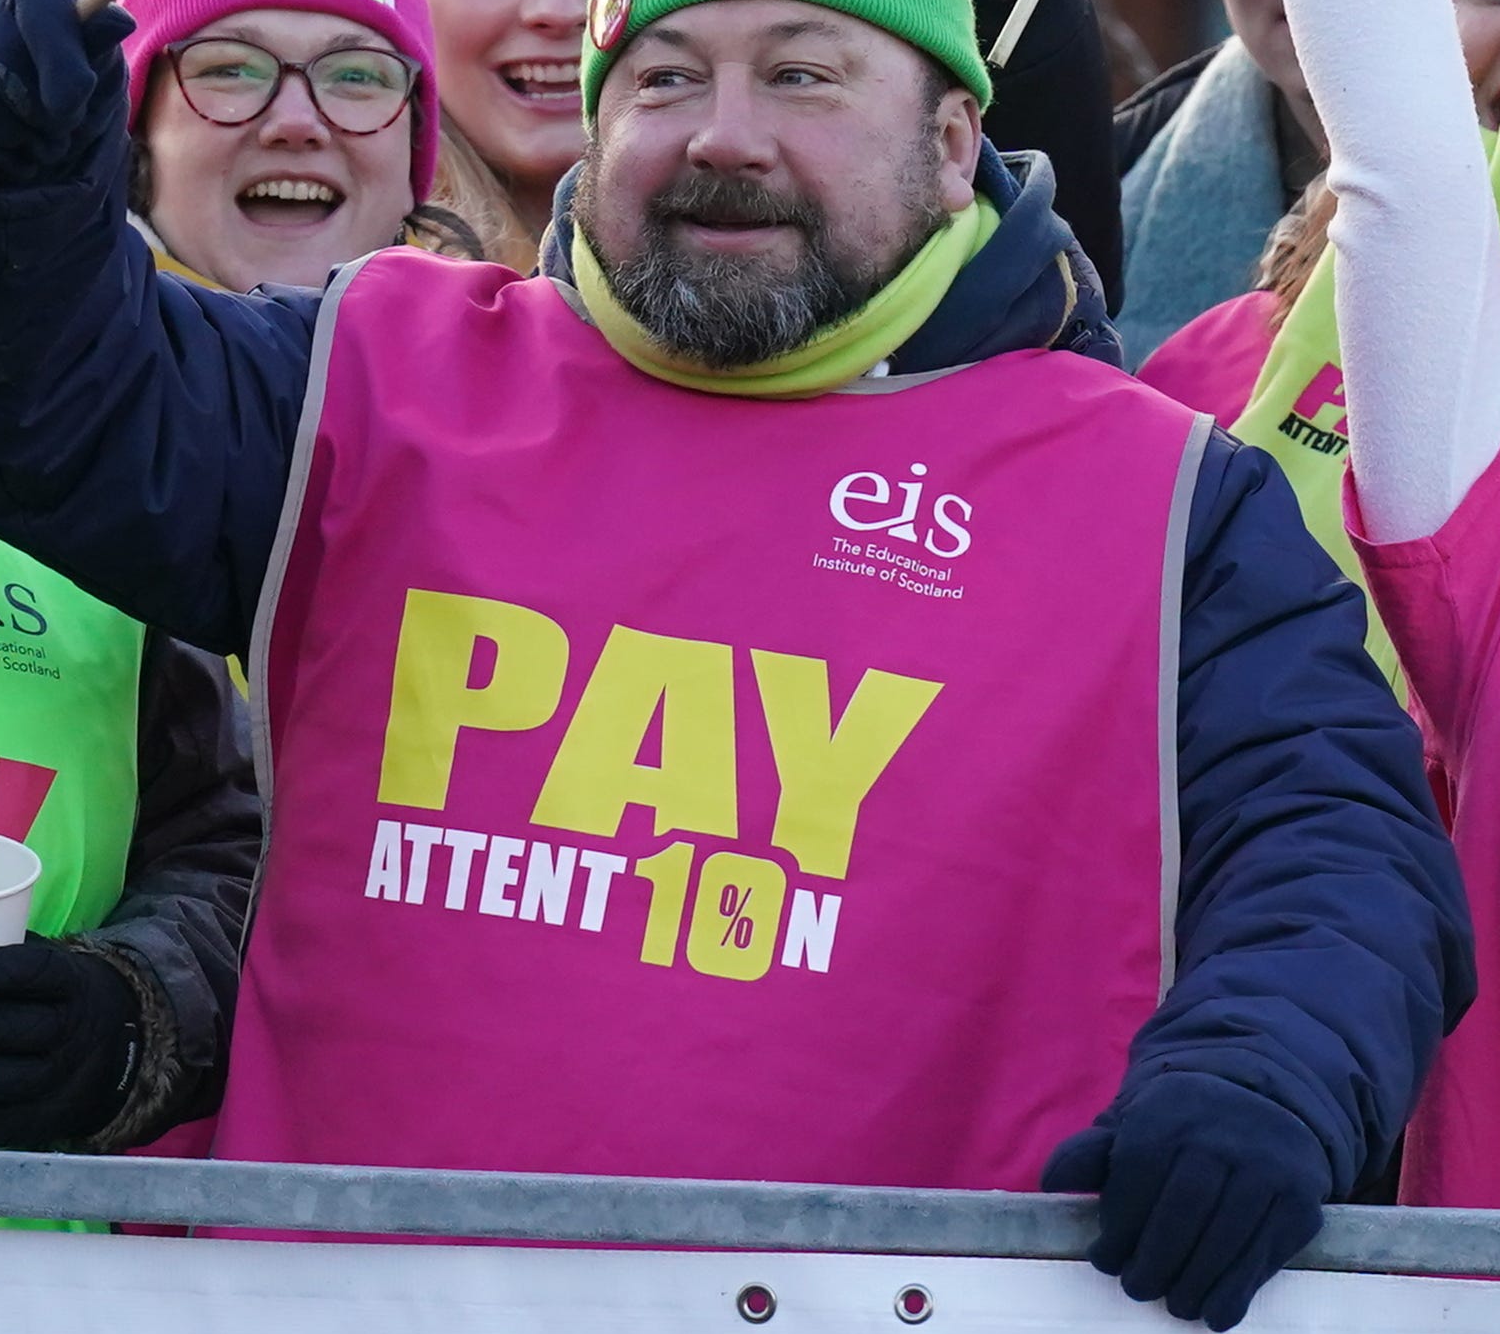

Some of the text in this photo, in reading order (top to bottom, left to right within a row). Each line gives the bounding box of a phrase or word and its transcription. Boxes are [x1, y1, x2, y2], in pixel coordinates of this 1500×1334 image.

[1278, 412, 1349, 457] ATTENT
[829, 462, 973, 558] eis
[813, 553, 964, 599] Institute of Scotland
[833, 537, 952, 581] The Educational
[3, 656, 61, 679] Scotland
[376, 587, 946, 881] PAY
